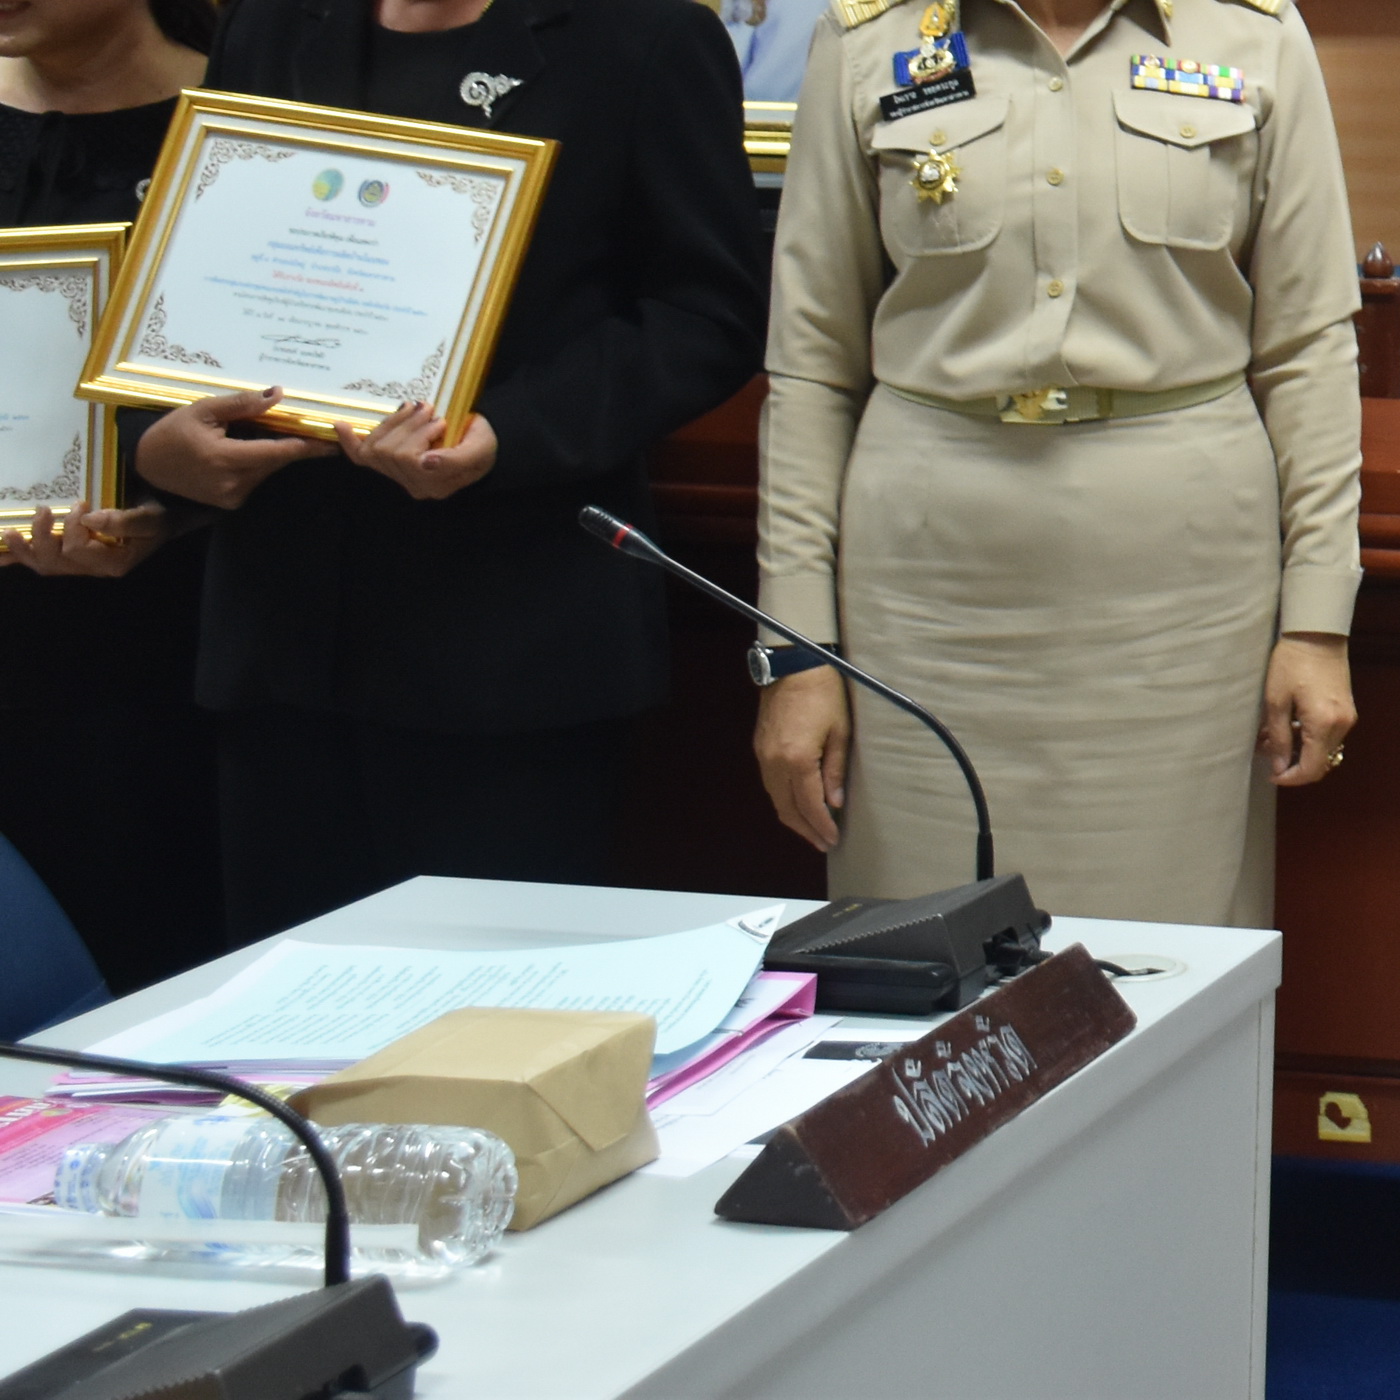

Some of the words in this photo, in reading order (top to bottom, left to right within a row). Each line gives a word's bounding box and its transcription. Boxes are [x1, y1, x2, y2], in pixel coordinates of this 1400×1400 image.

[892, 1014, 1038, 1148] ปลัดจังหวัด
